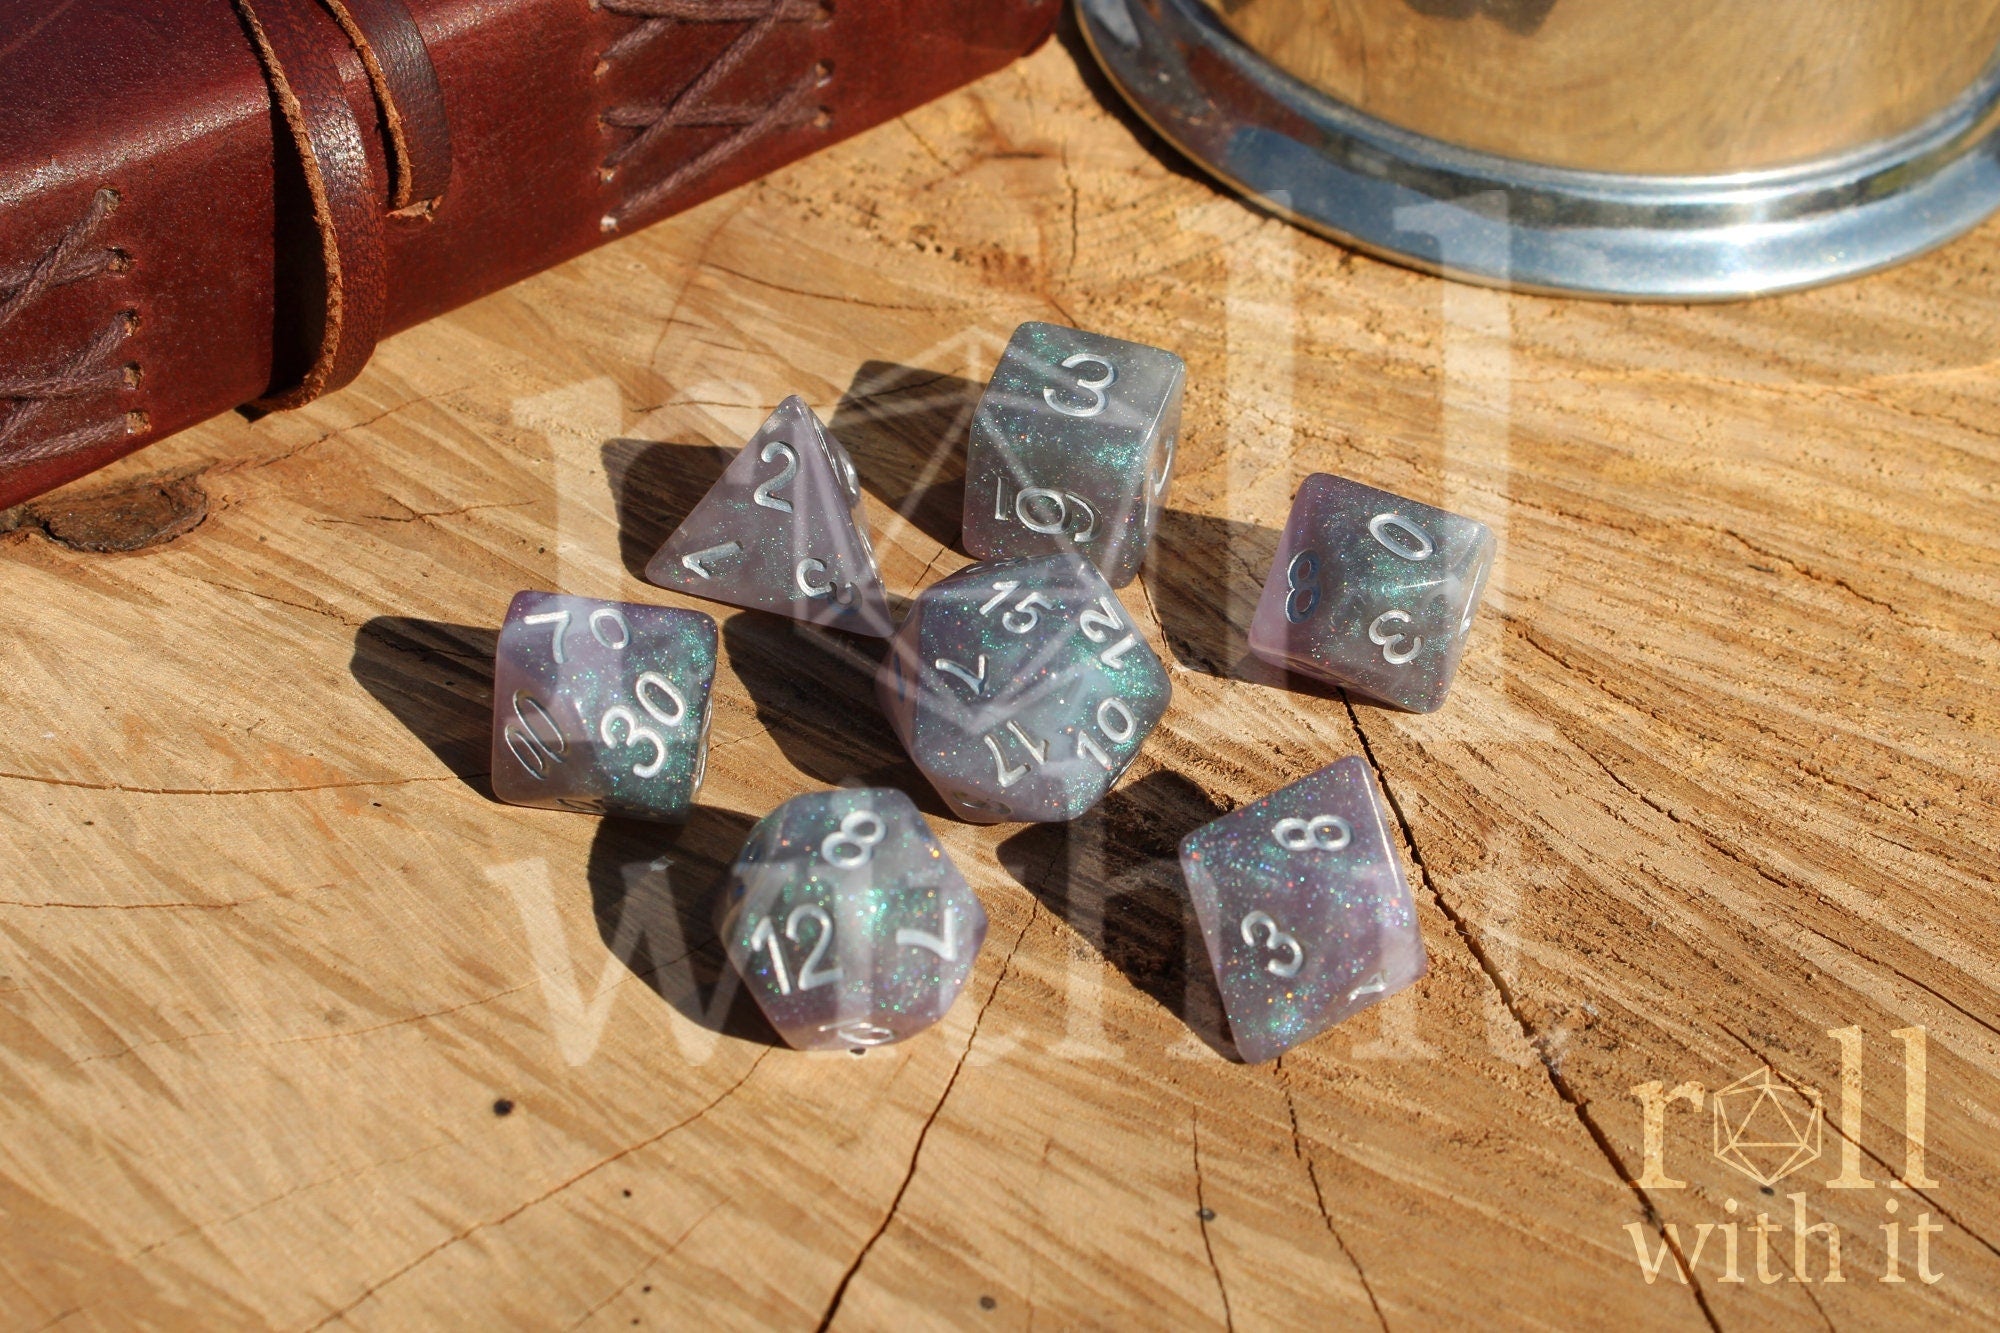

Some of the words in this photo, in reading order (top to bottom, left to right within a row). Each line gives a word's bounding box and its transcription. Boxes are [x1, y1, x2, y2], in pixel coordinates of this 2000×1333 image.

[1042, 352, 1117, 418] 3
[753, 440, 799, 514] 2
[681, 540, 743, 580] 1
[1369, 512, 1438, 561] 0
[979, 580, 1056, 634] 15
[1285, 549, 1322, 625] 8
[1079, 596, 1138, 670] 12
[1368, 609, 1424, 665] 3
[935, 653, 990, 695] 7
[600, 670, 687, 779] 30
[984, 719, 1049, 788] 17
[1077, 696, 1138, 769] 10
[821, 810, 887, 870] 8
[1272, 814, 1356, 851] 8
[751, 904, 844, 996] 12
[895, 908, 957, 963] 7
[1240, 910, 1304, 979] 3
